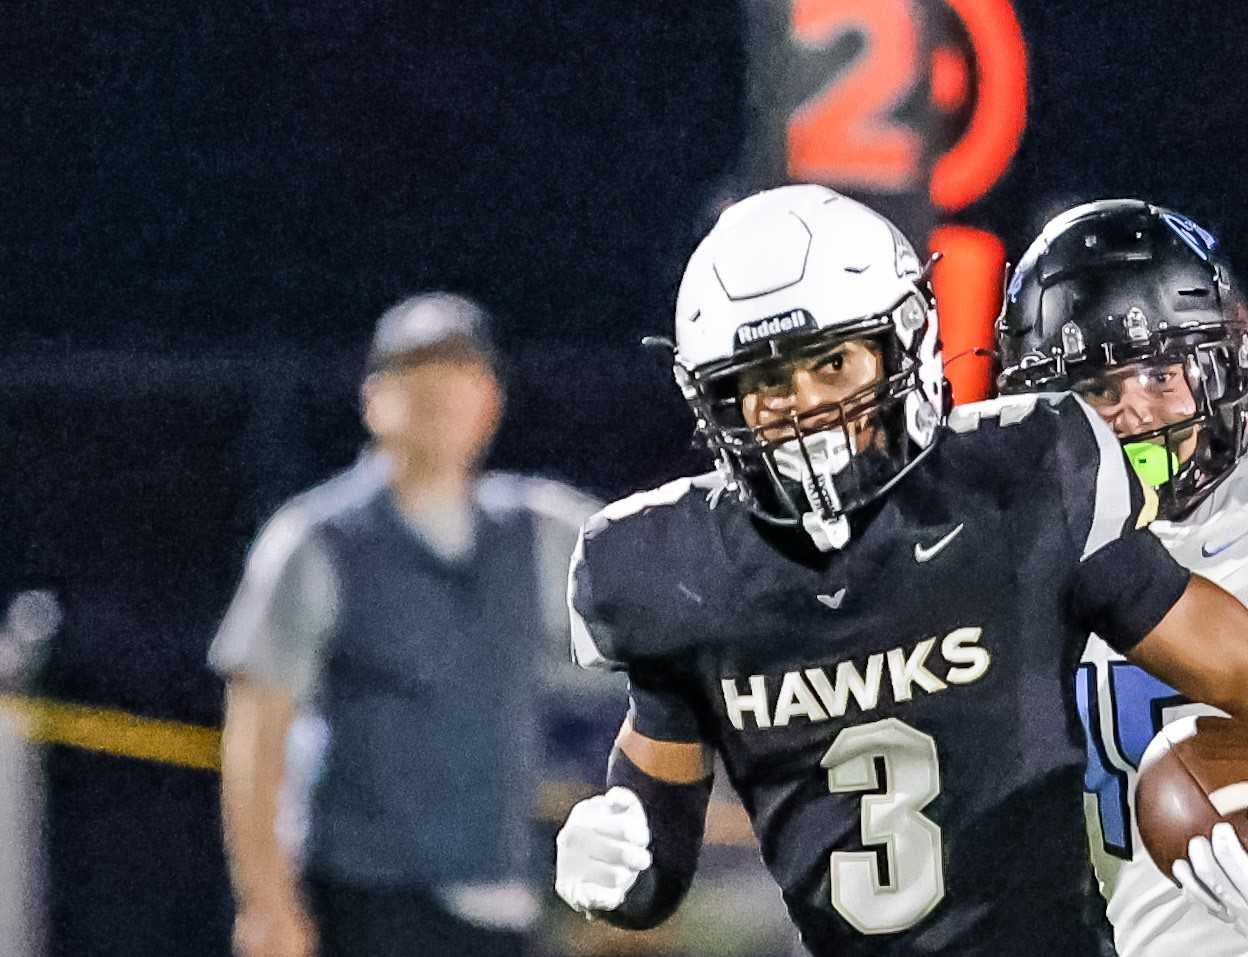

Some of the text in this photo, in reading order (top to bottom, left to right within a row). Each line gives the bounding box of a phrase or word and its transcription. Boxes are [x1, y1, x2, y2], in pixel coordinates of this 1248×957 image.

[787, 0, 919, 190] 2
[738, 310, 806, 344] Riddell
[721, 626, 991, 730] HAWKS
[819, 717, 945, 935] 3
